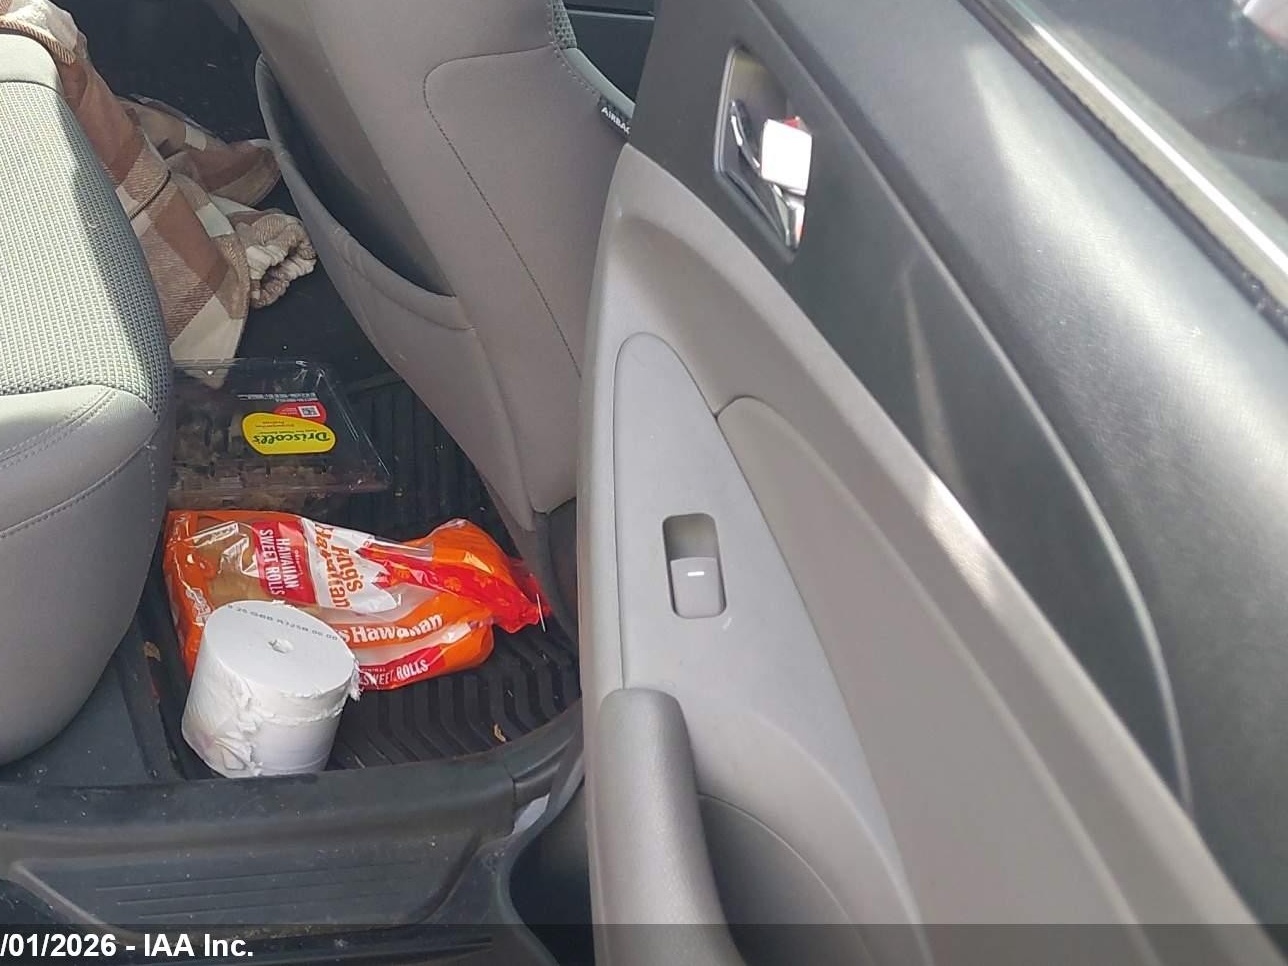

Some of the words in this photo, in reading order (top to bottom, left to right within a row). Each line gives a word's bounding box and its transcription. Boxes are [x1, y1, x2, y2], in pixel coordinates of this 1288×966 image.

[253, 431, 331, 445] Driscoll's
[259, 529, 279, 563] SWEET
[275, 537, 300, 590] HAWAIIAN
[265, 566, 287, 596] ROLLS
[396, 659, 430, 681] ROLLS
